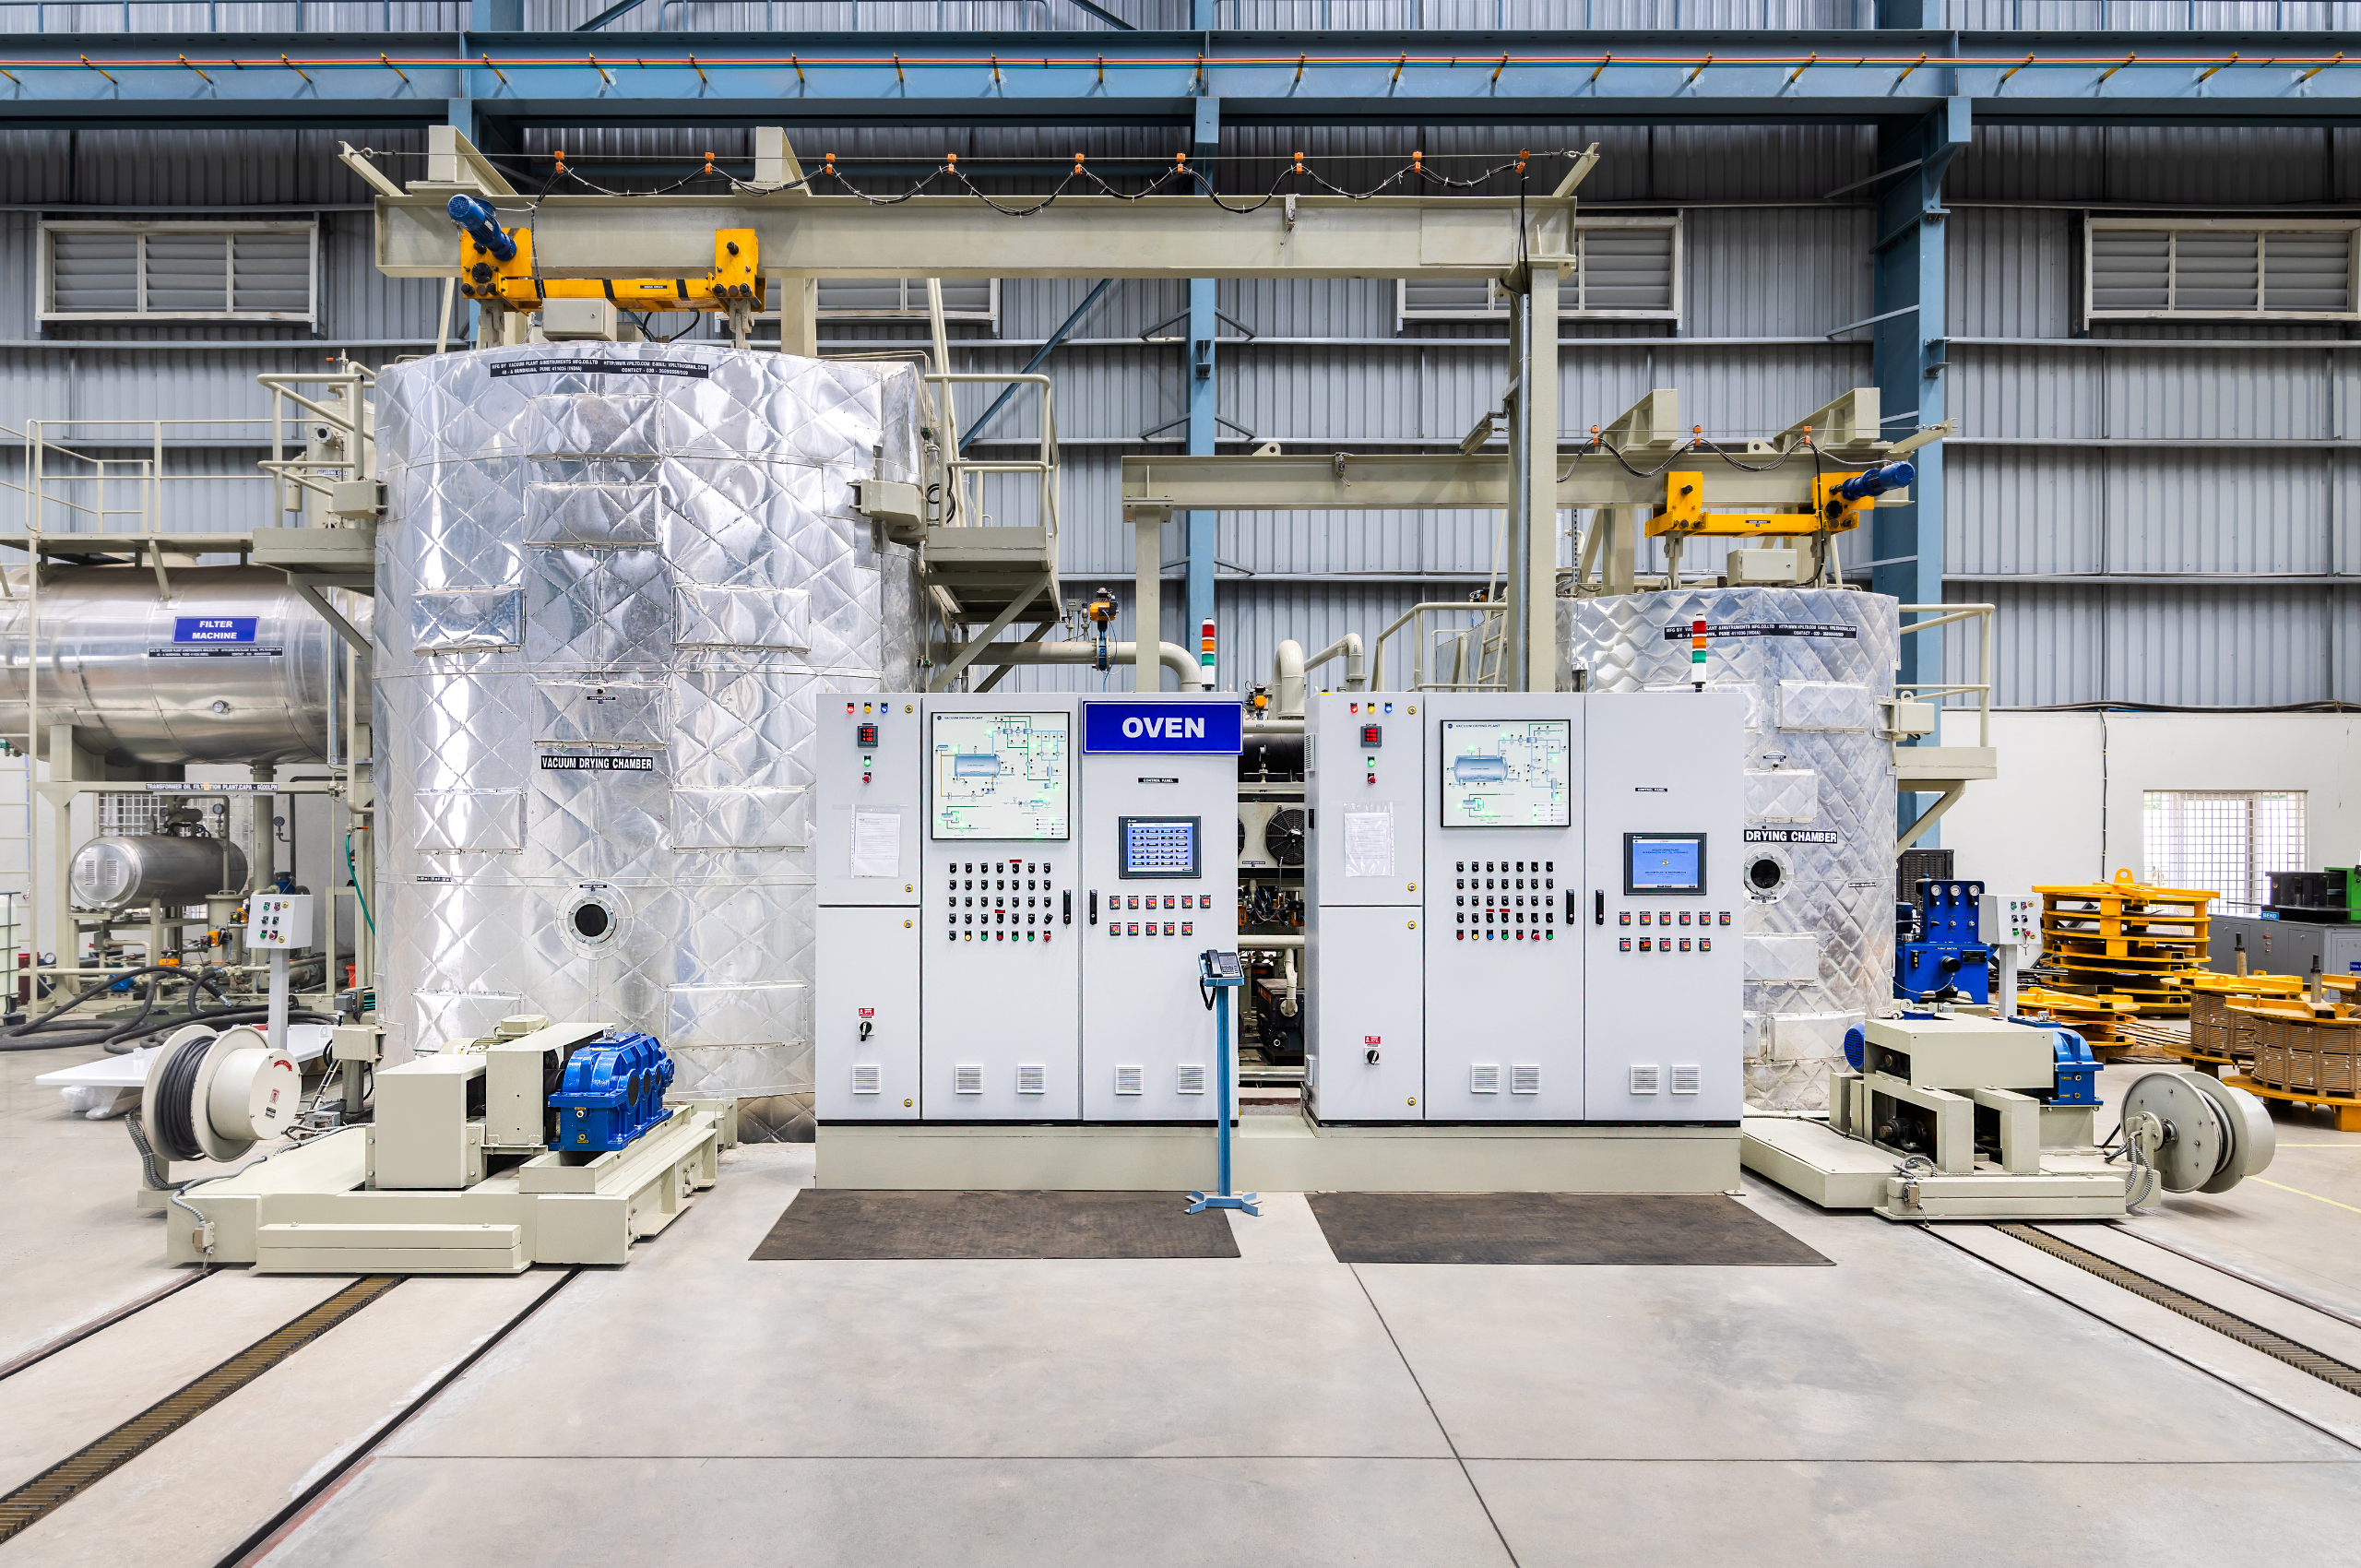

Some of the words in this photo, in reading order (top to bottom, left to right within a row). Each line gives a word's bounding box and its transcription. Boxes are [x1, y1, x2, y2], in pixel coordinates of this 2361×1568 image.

[199, 620, 233, 628] FILTER
[1121, 717, 1205, 739] OVEN
[542, 757, 576, 768] VACUUM
[578, 757, 610, 769] DRYING
[611, 757, 652, 769] CHAMBER
[1746, 830, 1787, 841] DRYING
[1790, 831, 1837, 843] CHAMBER
